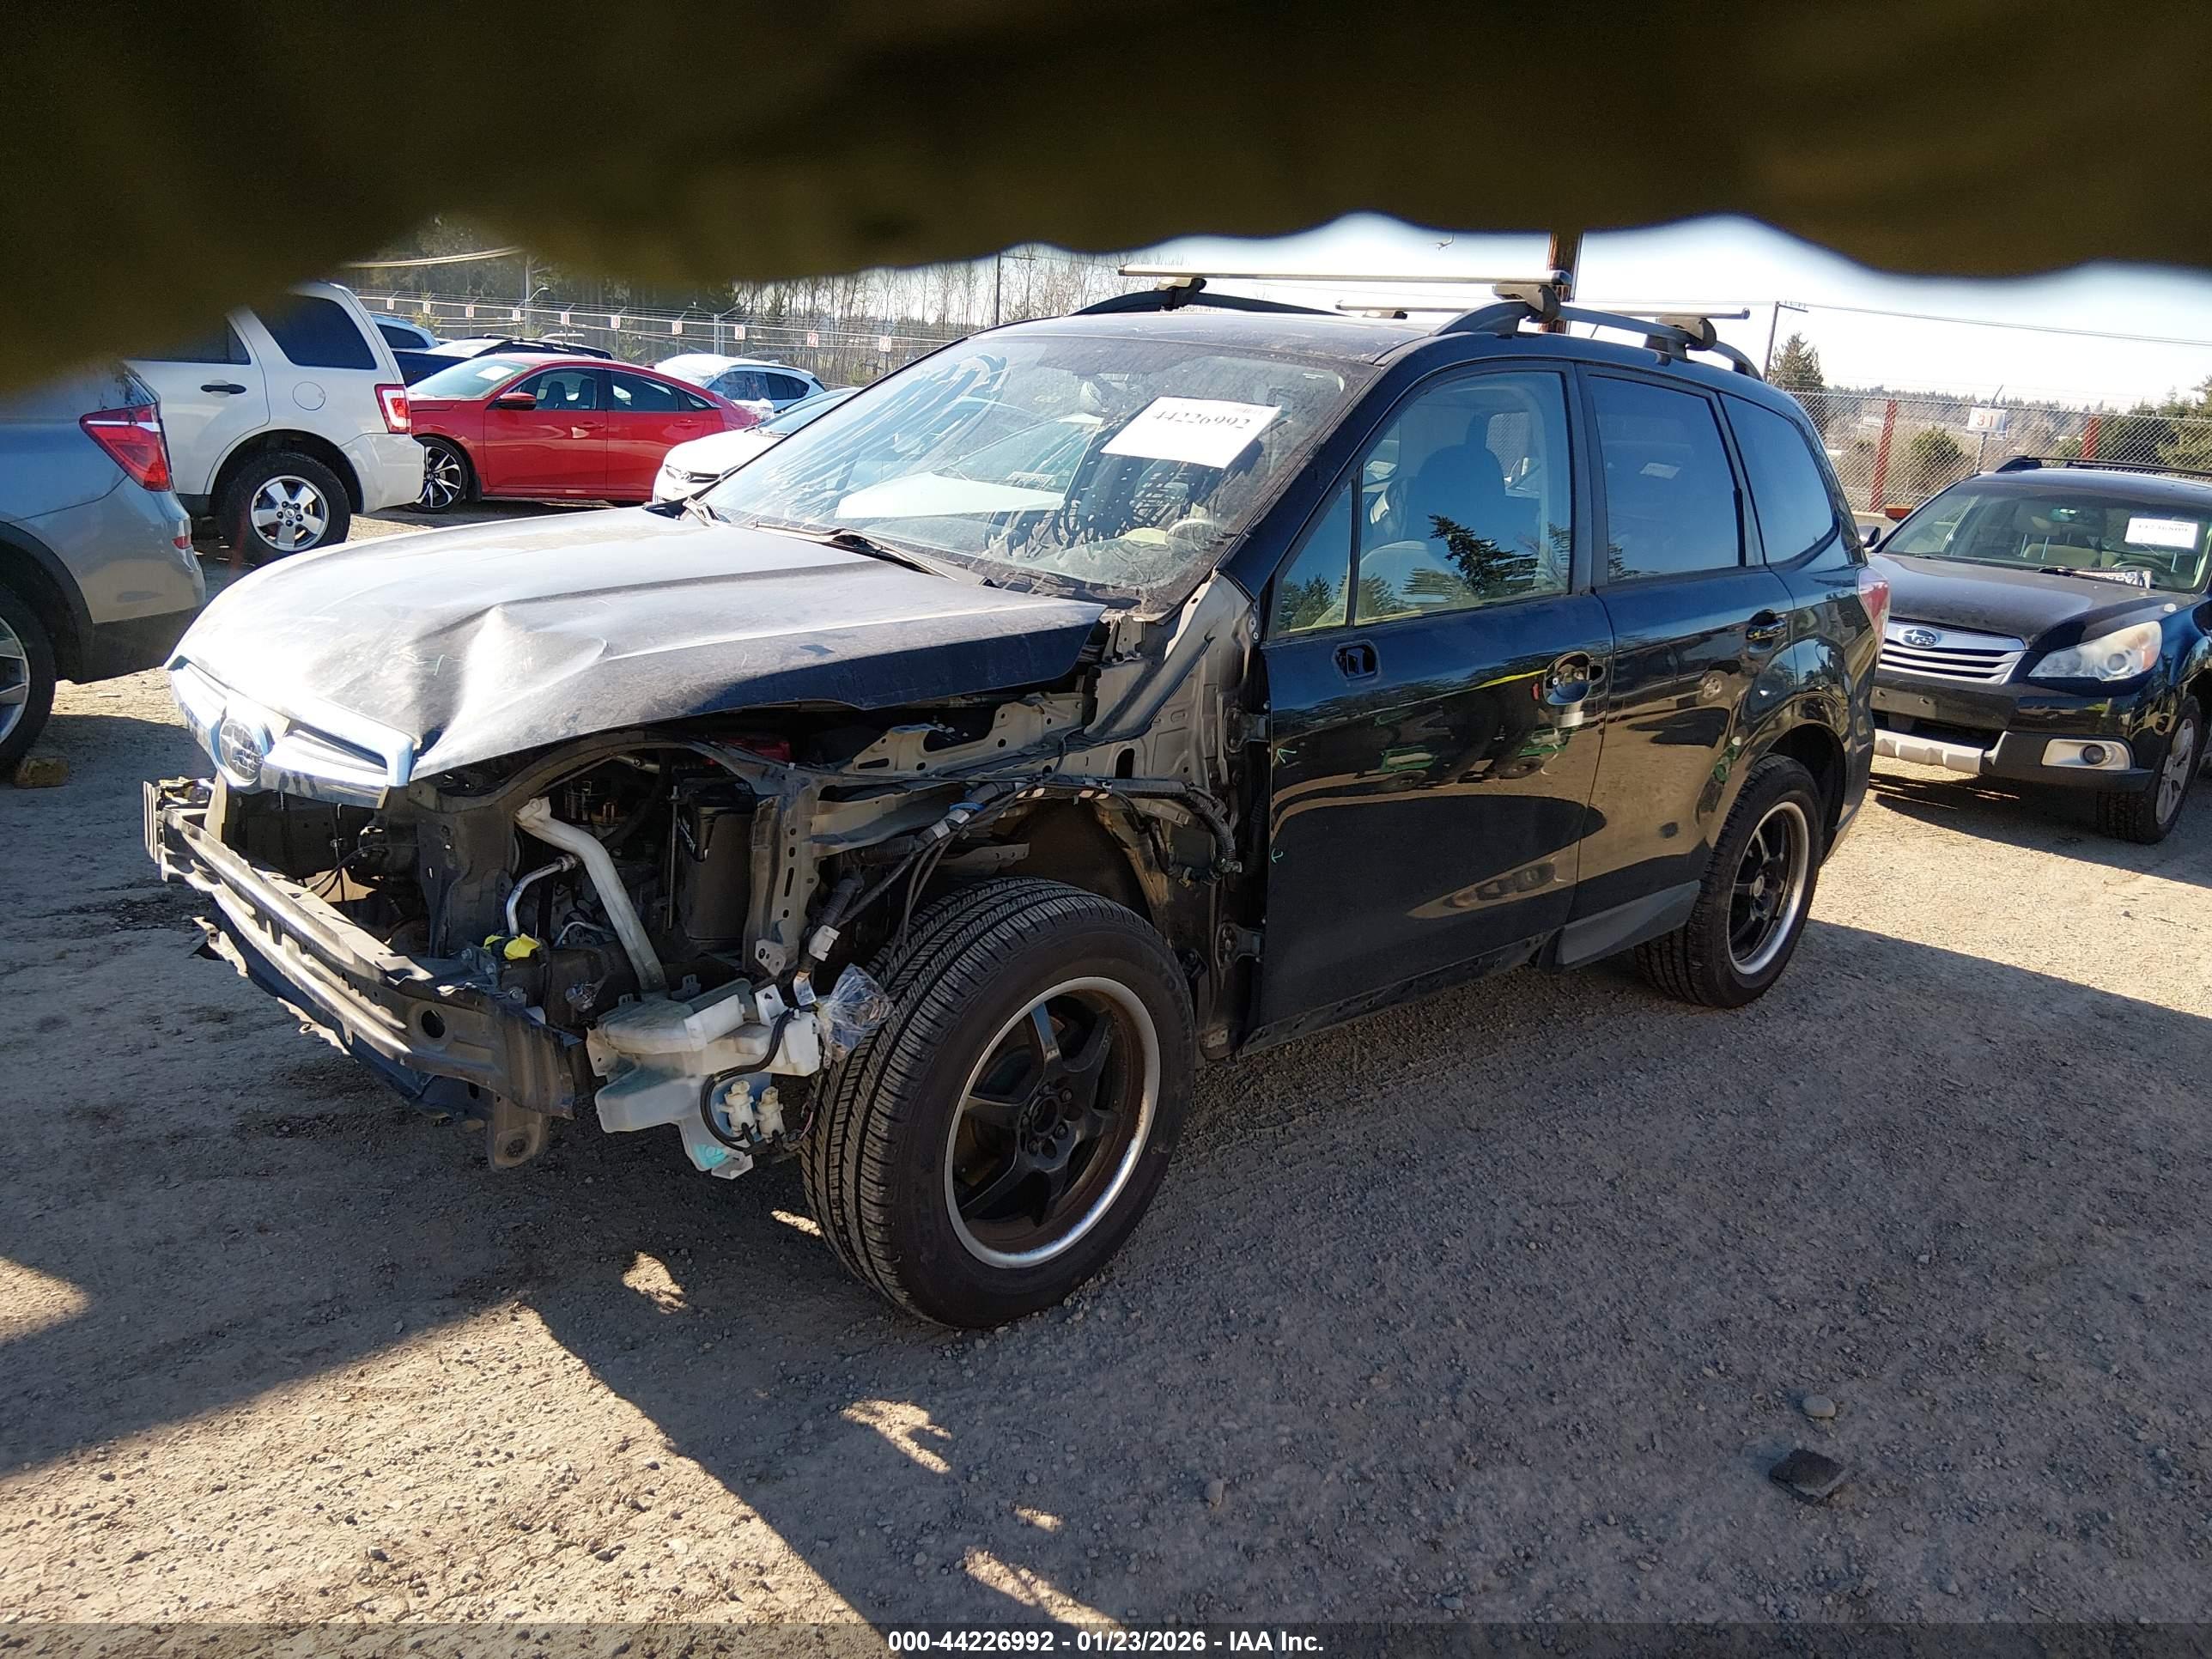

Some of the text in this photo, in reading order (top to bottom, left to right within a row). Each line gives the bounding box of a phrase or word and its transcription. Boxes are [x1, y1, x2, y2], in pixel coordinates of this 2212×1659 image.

[673, 322, 681, 333] 20
[737, 328, 744, 338] 21
[808, 334, 817, 346] 22
[880, 338, 890, 350] 23
[1977, 415, 1993, 428] 31
